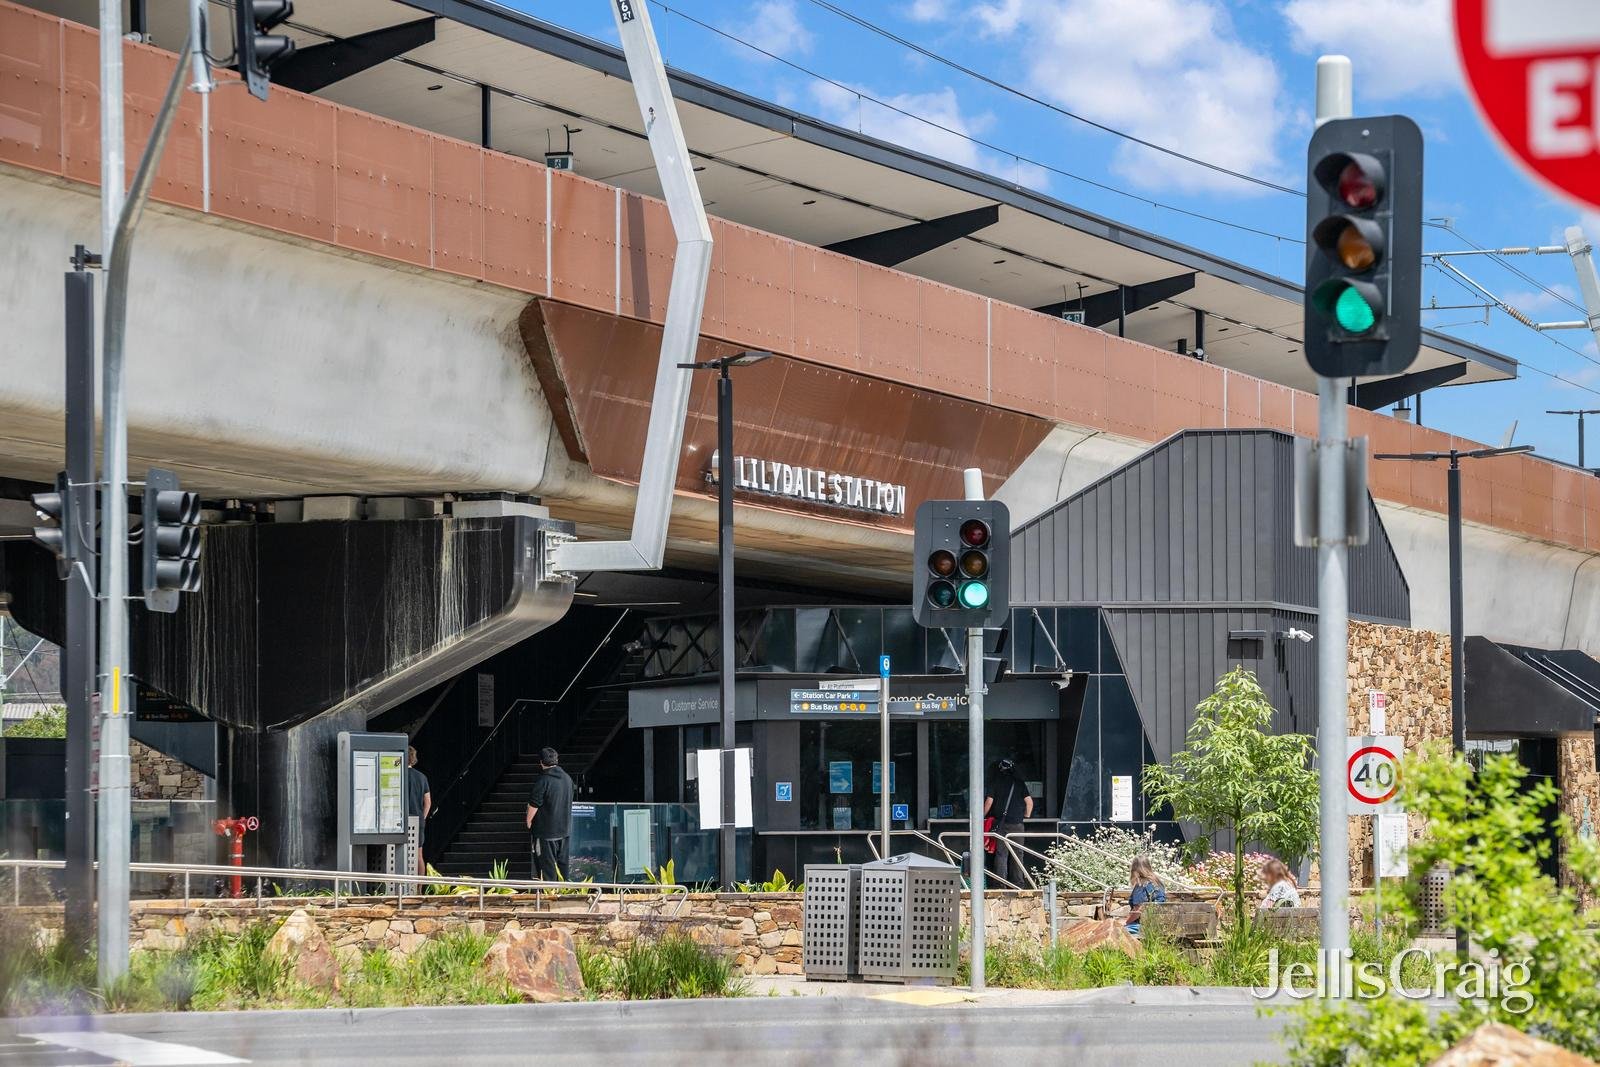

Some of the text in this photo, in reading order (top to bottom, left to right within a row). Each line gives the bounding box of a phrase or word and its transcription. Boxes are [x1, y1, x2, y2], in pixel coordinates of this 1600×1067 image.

[1526, 57, 1600, 161] E
[737, 456, 906, 514] LILYDALE STATION
[671, 698, 718, 712] Customer Service
[823, 704, 838, 712] Bays
[889, 695, 923, 703] omer
[927, 693, 970, 706] Servic
[1353, 763, 1393, 788] 40
